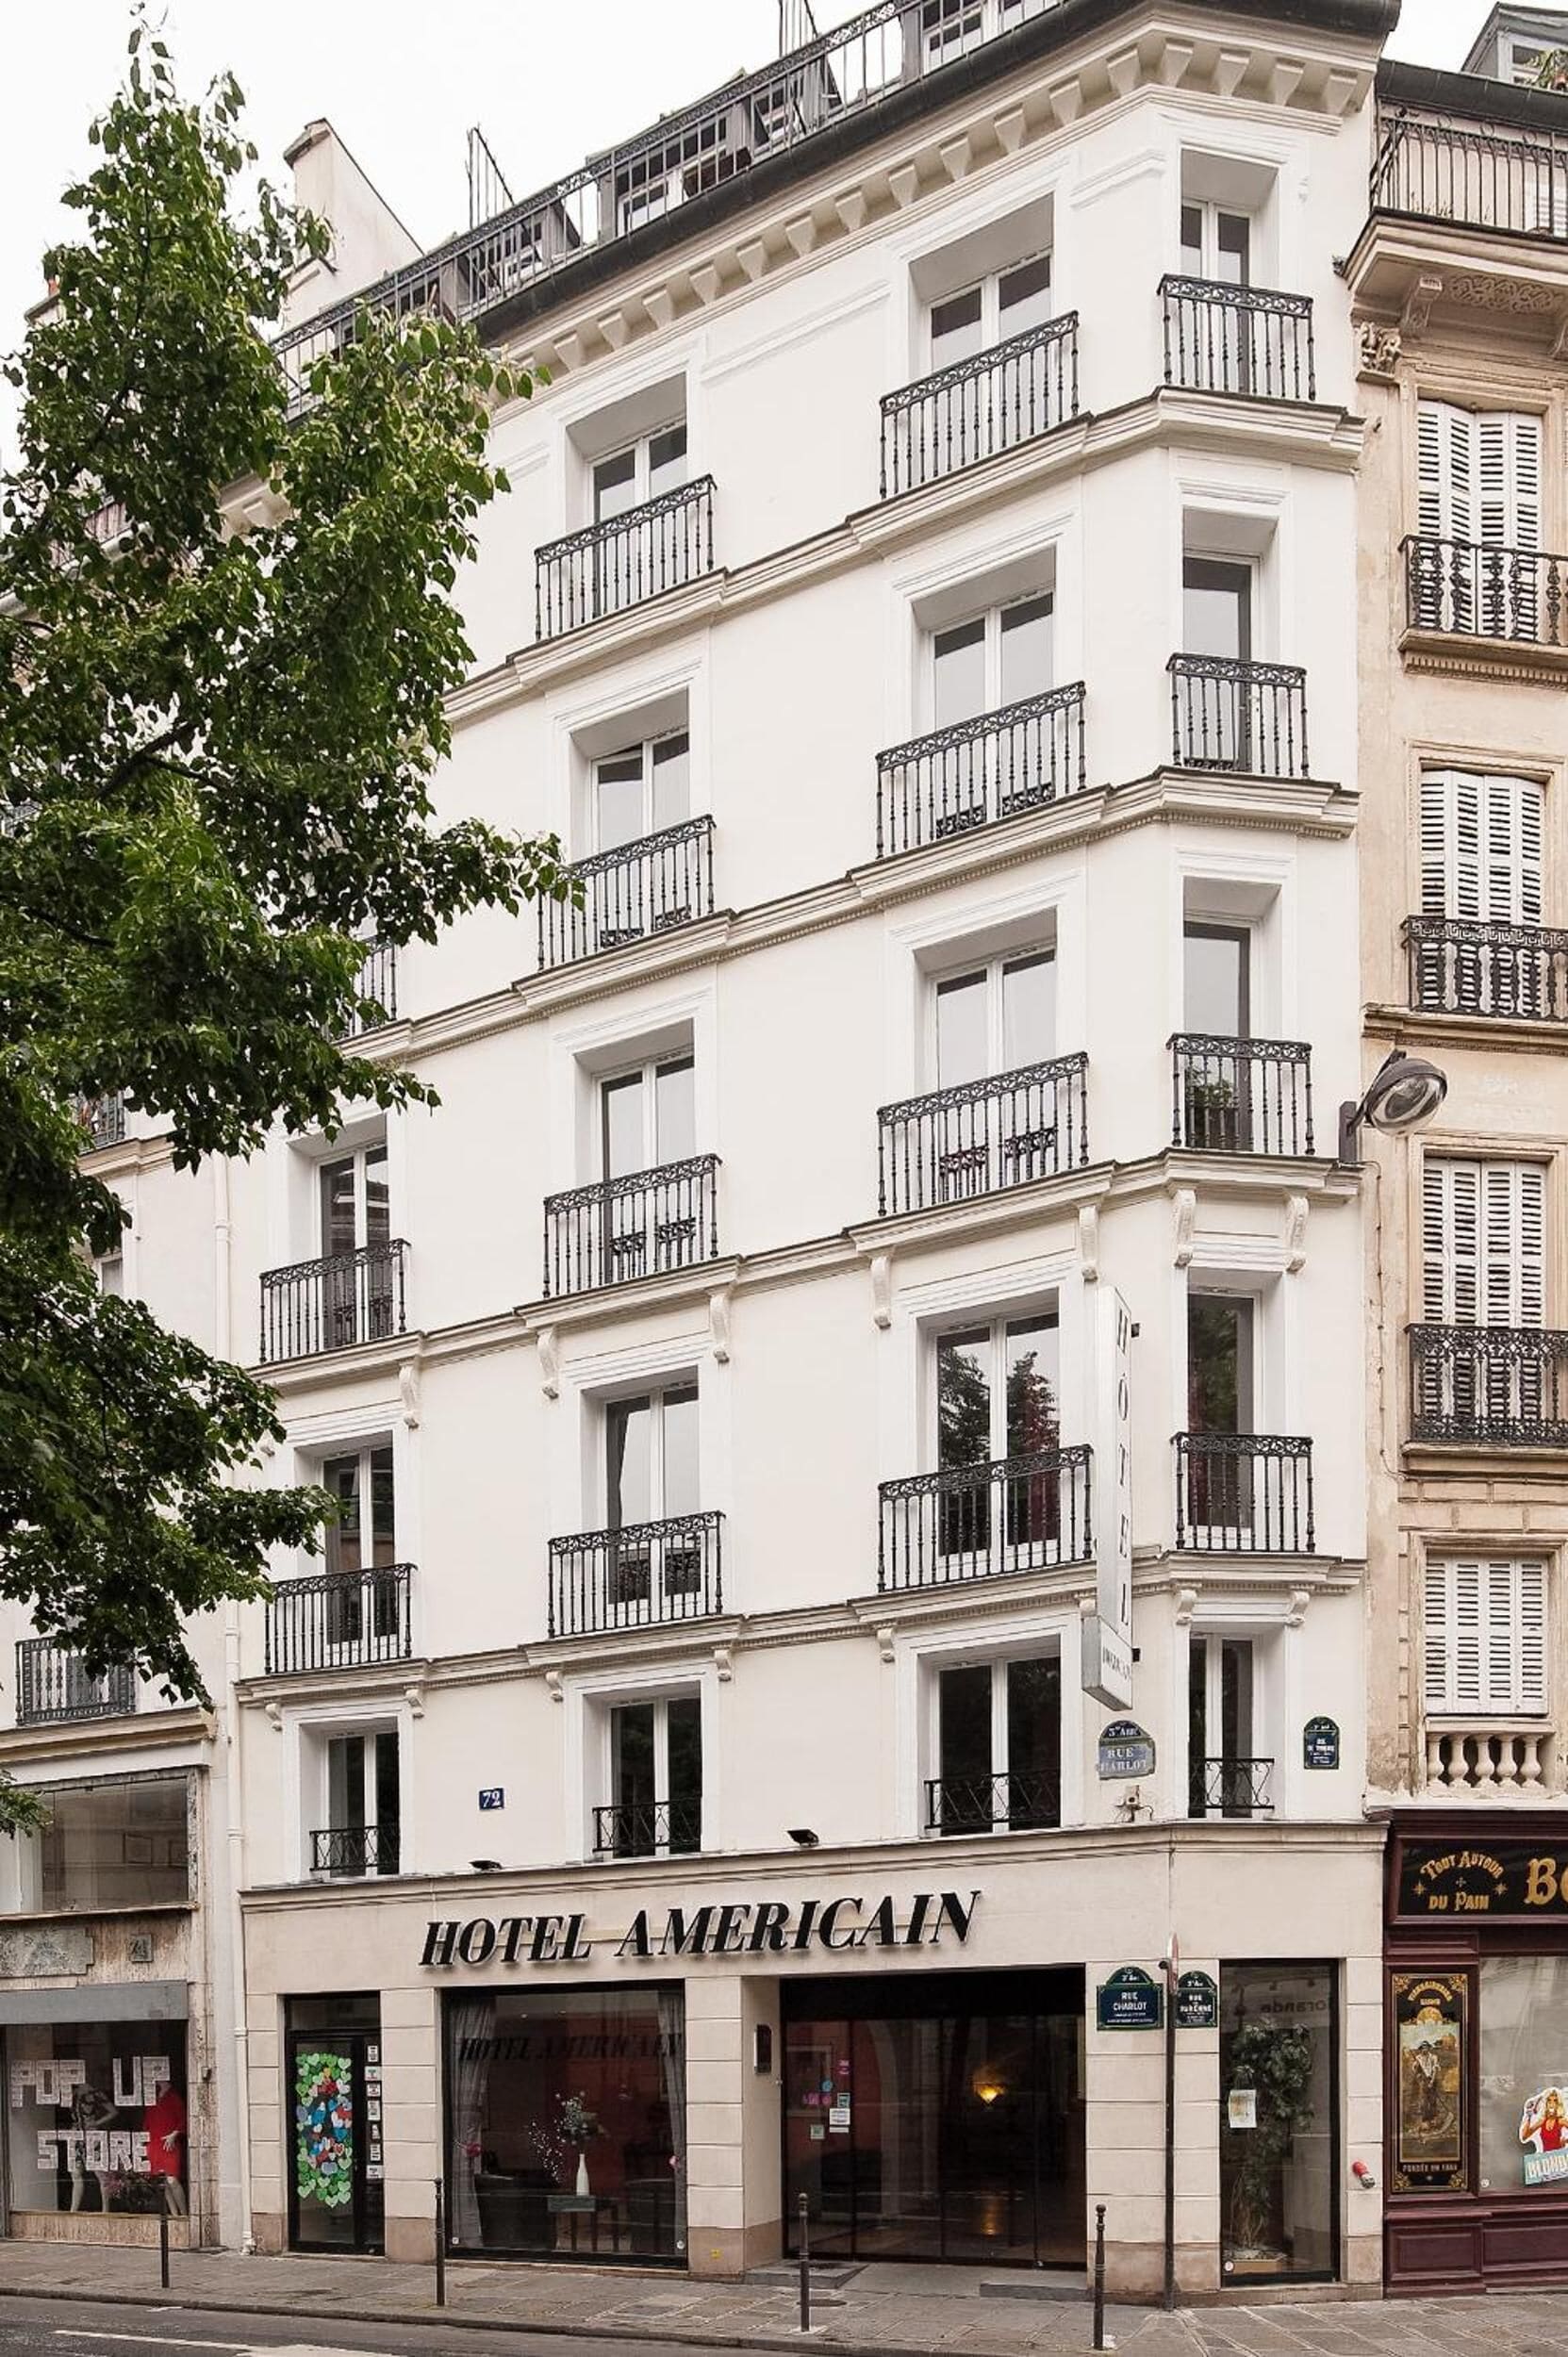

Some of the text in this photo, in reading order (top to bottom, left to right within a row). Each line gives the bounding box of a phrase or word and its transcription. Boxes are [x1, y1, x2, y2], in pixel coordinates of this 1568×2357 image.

[1107, 1746, 1134, 1759] RUE
[483, 1790, 501, 1808] 72
[1428, 1895, 1448, 1910] DU
[419, 1889, 982, 1967] HOTEL AMERICAIN
[1121, 1990, 1139, 2000] RUE
[1113, 2002, 1147, 2011] CHARLOT
[10, 2055, 171, 2108] POP UP
[37, 2130, 152, 2172] STORE
